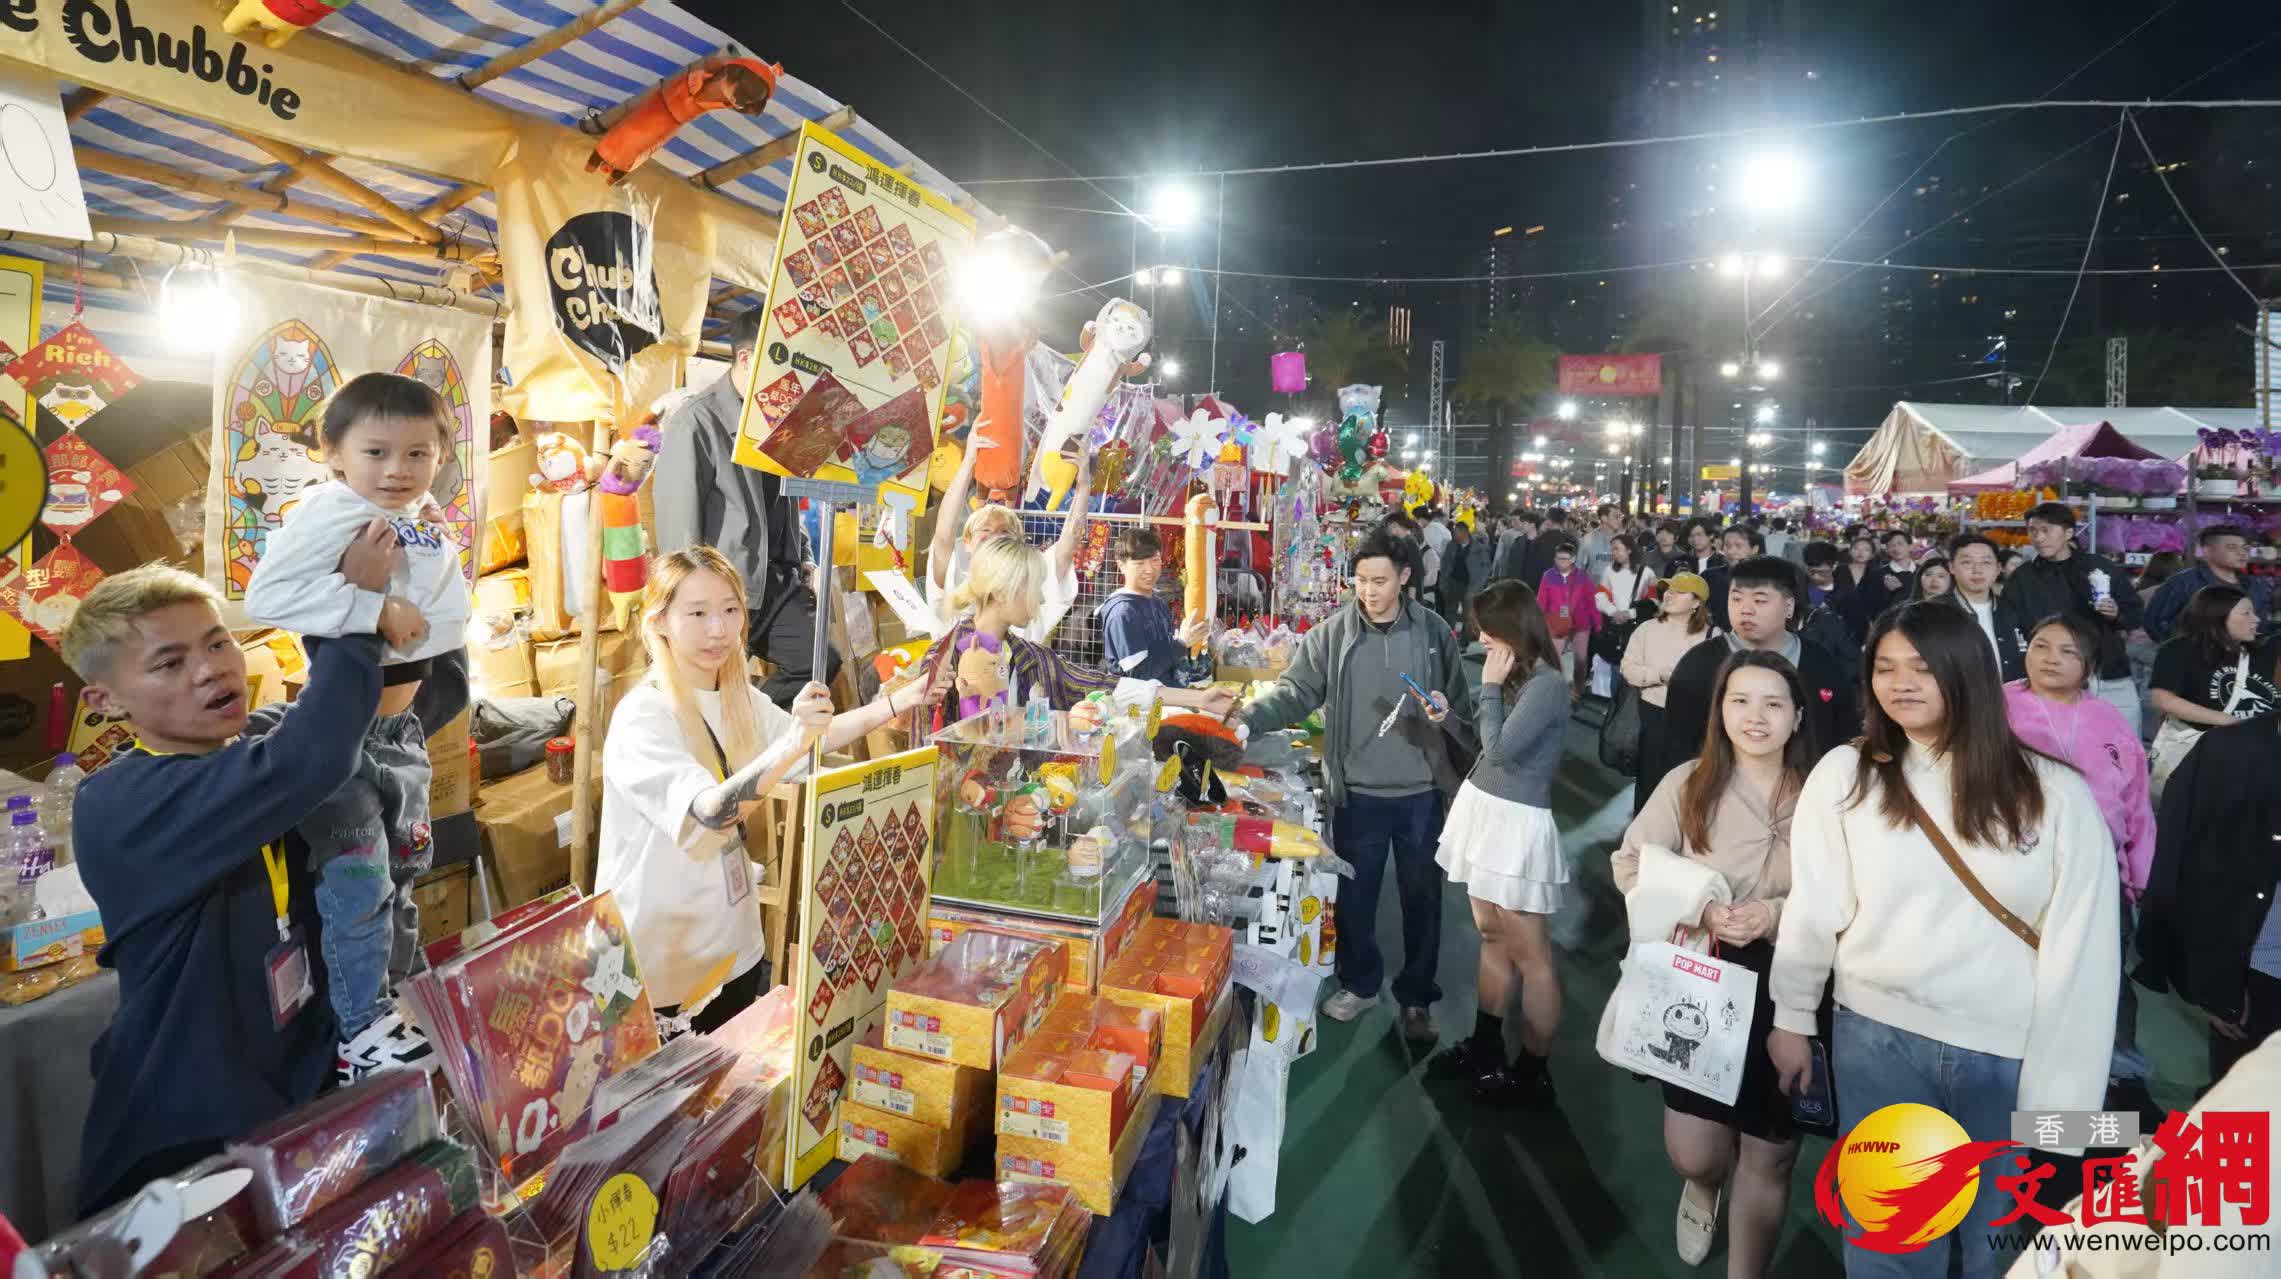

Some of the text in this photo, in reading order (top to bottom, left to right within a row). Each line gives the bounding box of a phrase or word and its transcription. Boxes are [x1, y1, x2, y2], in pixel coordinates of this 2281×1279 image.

[62, 0, 300, 120] Chubbie
[865, 164, 921, 208] 鴻運揮春
[550, 244, 634, 291] Chub
[44, 344, 111, 368] Rich
[65, 332, 94, 345] I'm
[1674, 956, 1719, 980] POP MART
[608, 1216, 640, 1254] $22
